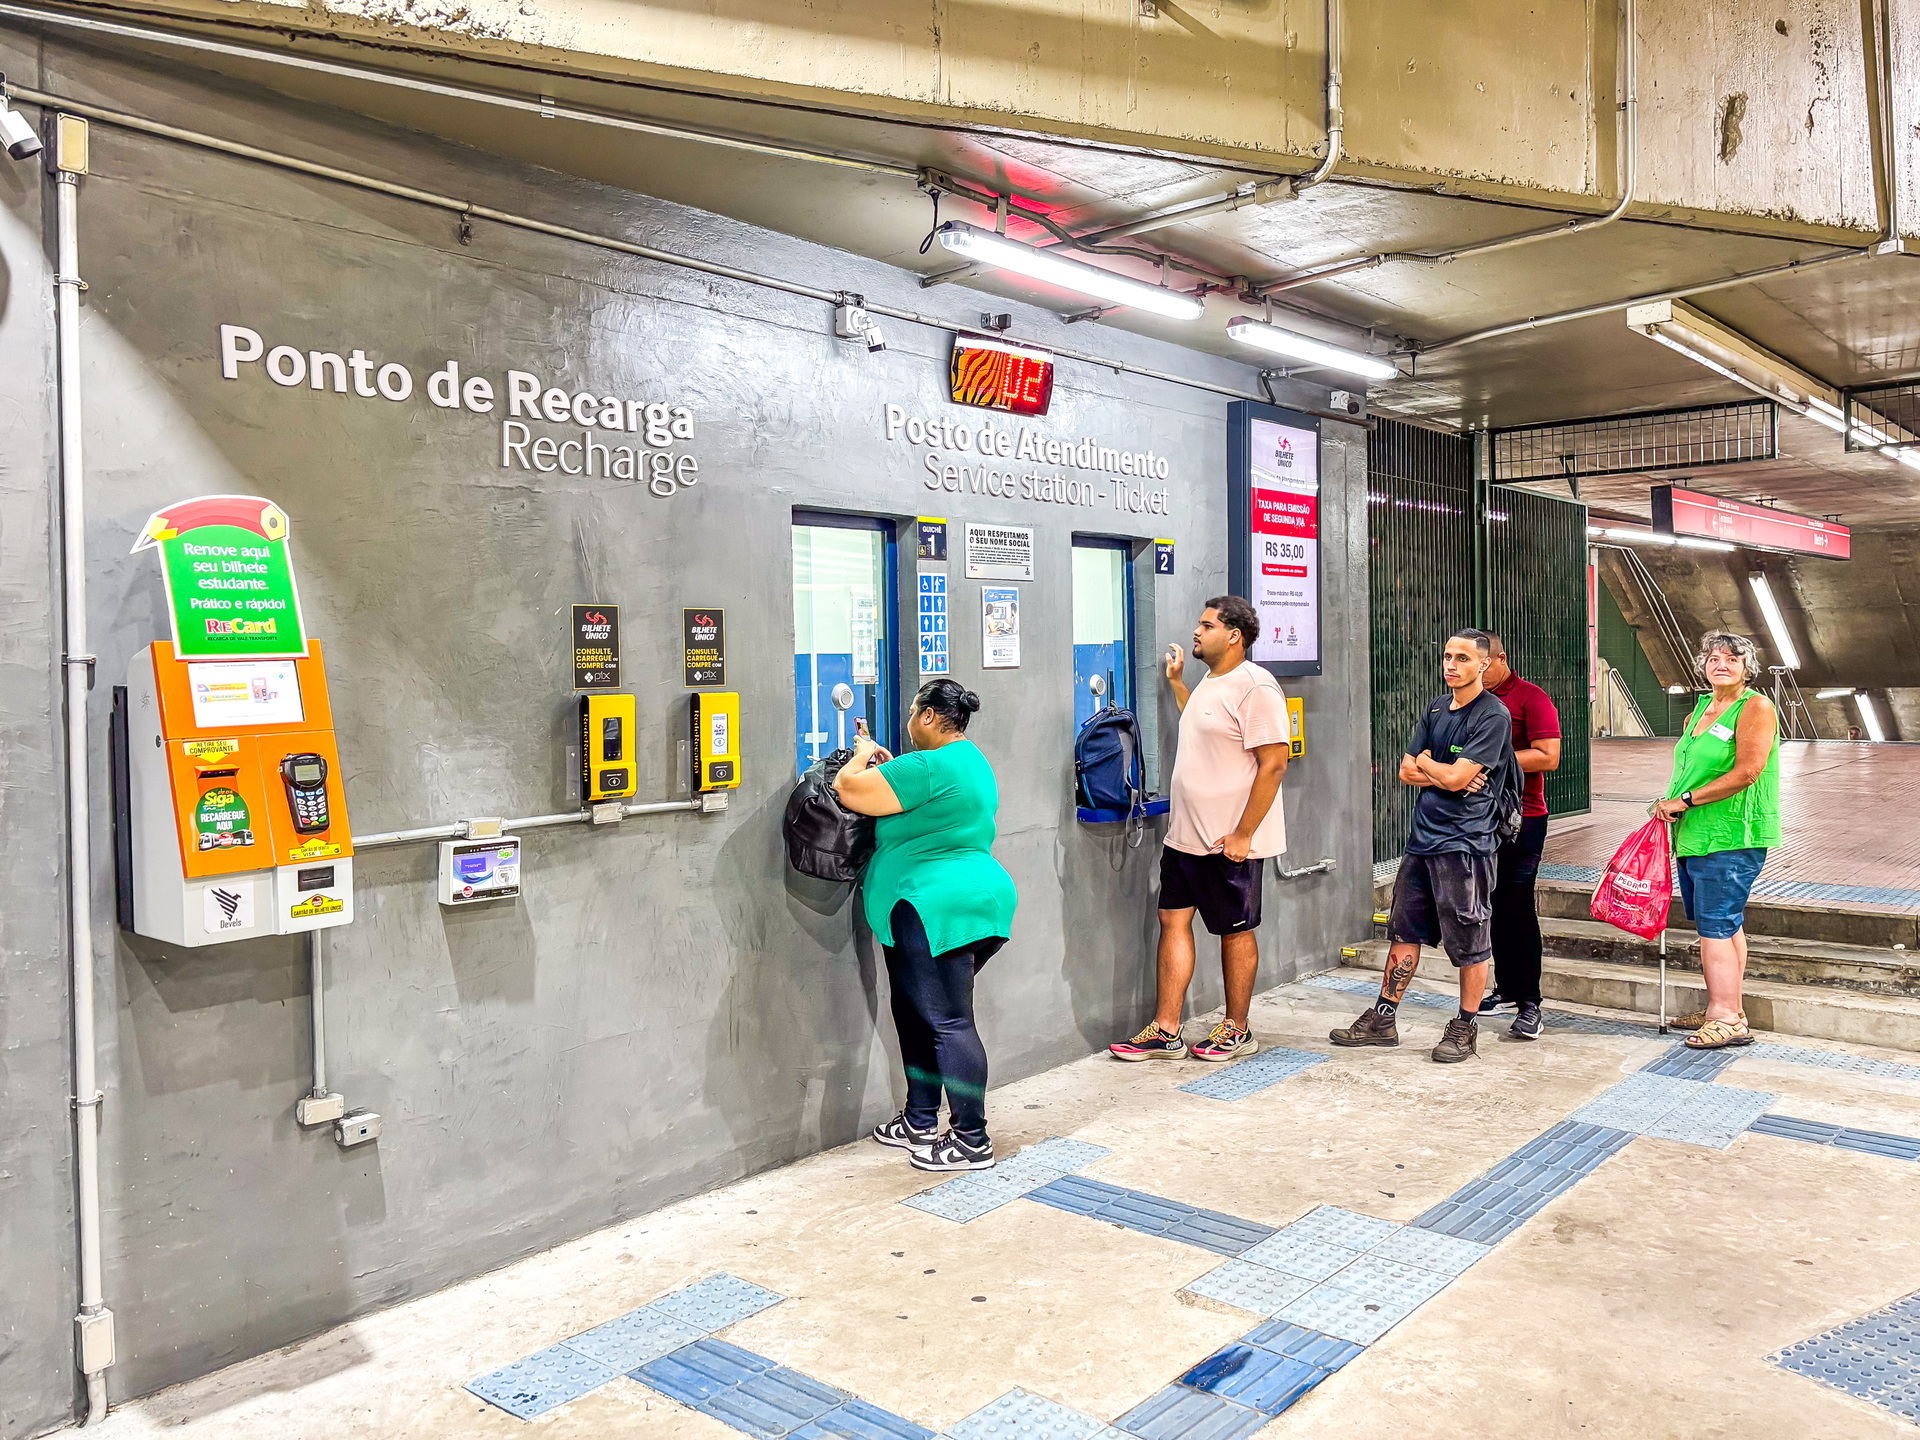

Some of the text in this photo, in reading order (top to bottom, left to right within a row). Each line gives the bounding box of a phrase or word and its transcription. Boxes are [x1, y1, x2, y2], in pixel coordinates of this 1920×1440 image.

[220, 323, 694, 448] Ponto de Recarga
[885, 402, 1170, 480] Posto de Atendimento
[502, 420, 699, 496] Recharge
[1275, 450, 1294, 460] BILHETE
[924, 452, 1170, 515] Service station - Ticket
[1257, 499, 1310, 515] TAXA PARA EMISSÃO
[1263, 513, 1305, 527] DE SEGUNDA VIA
[922, 525, 942, 534] GUICHÊ
[970, 528, 1029, 540] AQUI RESPEITAMOS
[927, 534, 935, 556] 1
[989, 538, 1007, 546] NOME
[1009, 539, 1030, 548] SOCIAL
[183, 542, 270, 560] Renove aqui
[1265, 541, 1304, 560] R$ 35,00
[193, 560, 268, 574] seu bilhete
[1160, 553, 1168, 571] 2
[198, 577, 269, 590] estudante.
[190, 598, 286, 612] Prático e rápido!
[691, 626, 717, 634] BILHETE
[594, 671, 611, 682] pix
[702, 670, 717, 680] pix
[189, 745, 234, 755] COMPROVANTE
[204, 791, 235, 808] Siga
[200, 810, 246, 823] RECARREGUE
[216, 821, 233, 831] AQUI
[498, 850, 513, 858] Siga
[293, 908, 308, 917] CARTÃO
[220, 918, 242, 930] Devels
